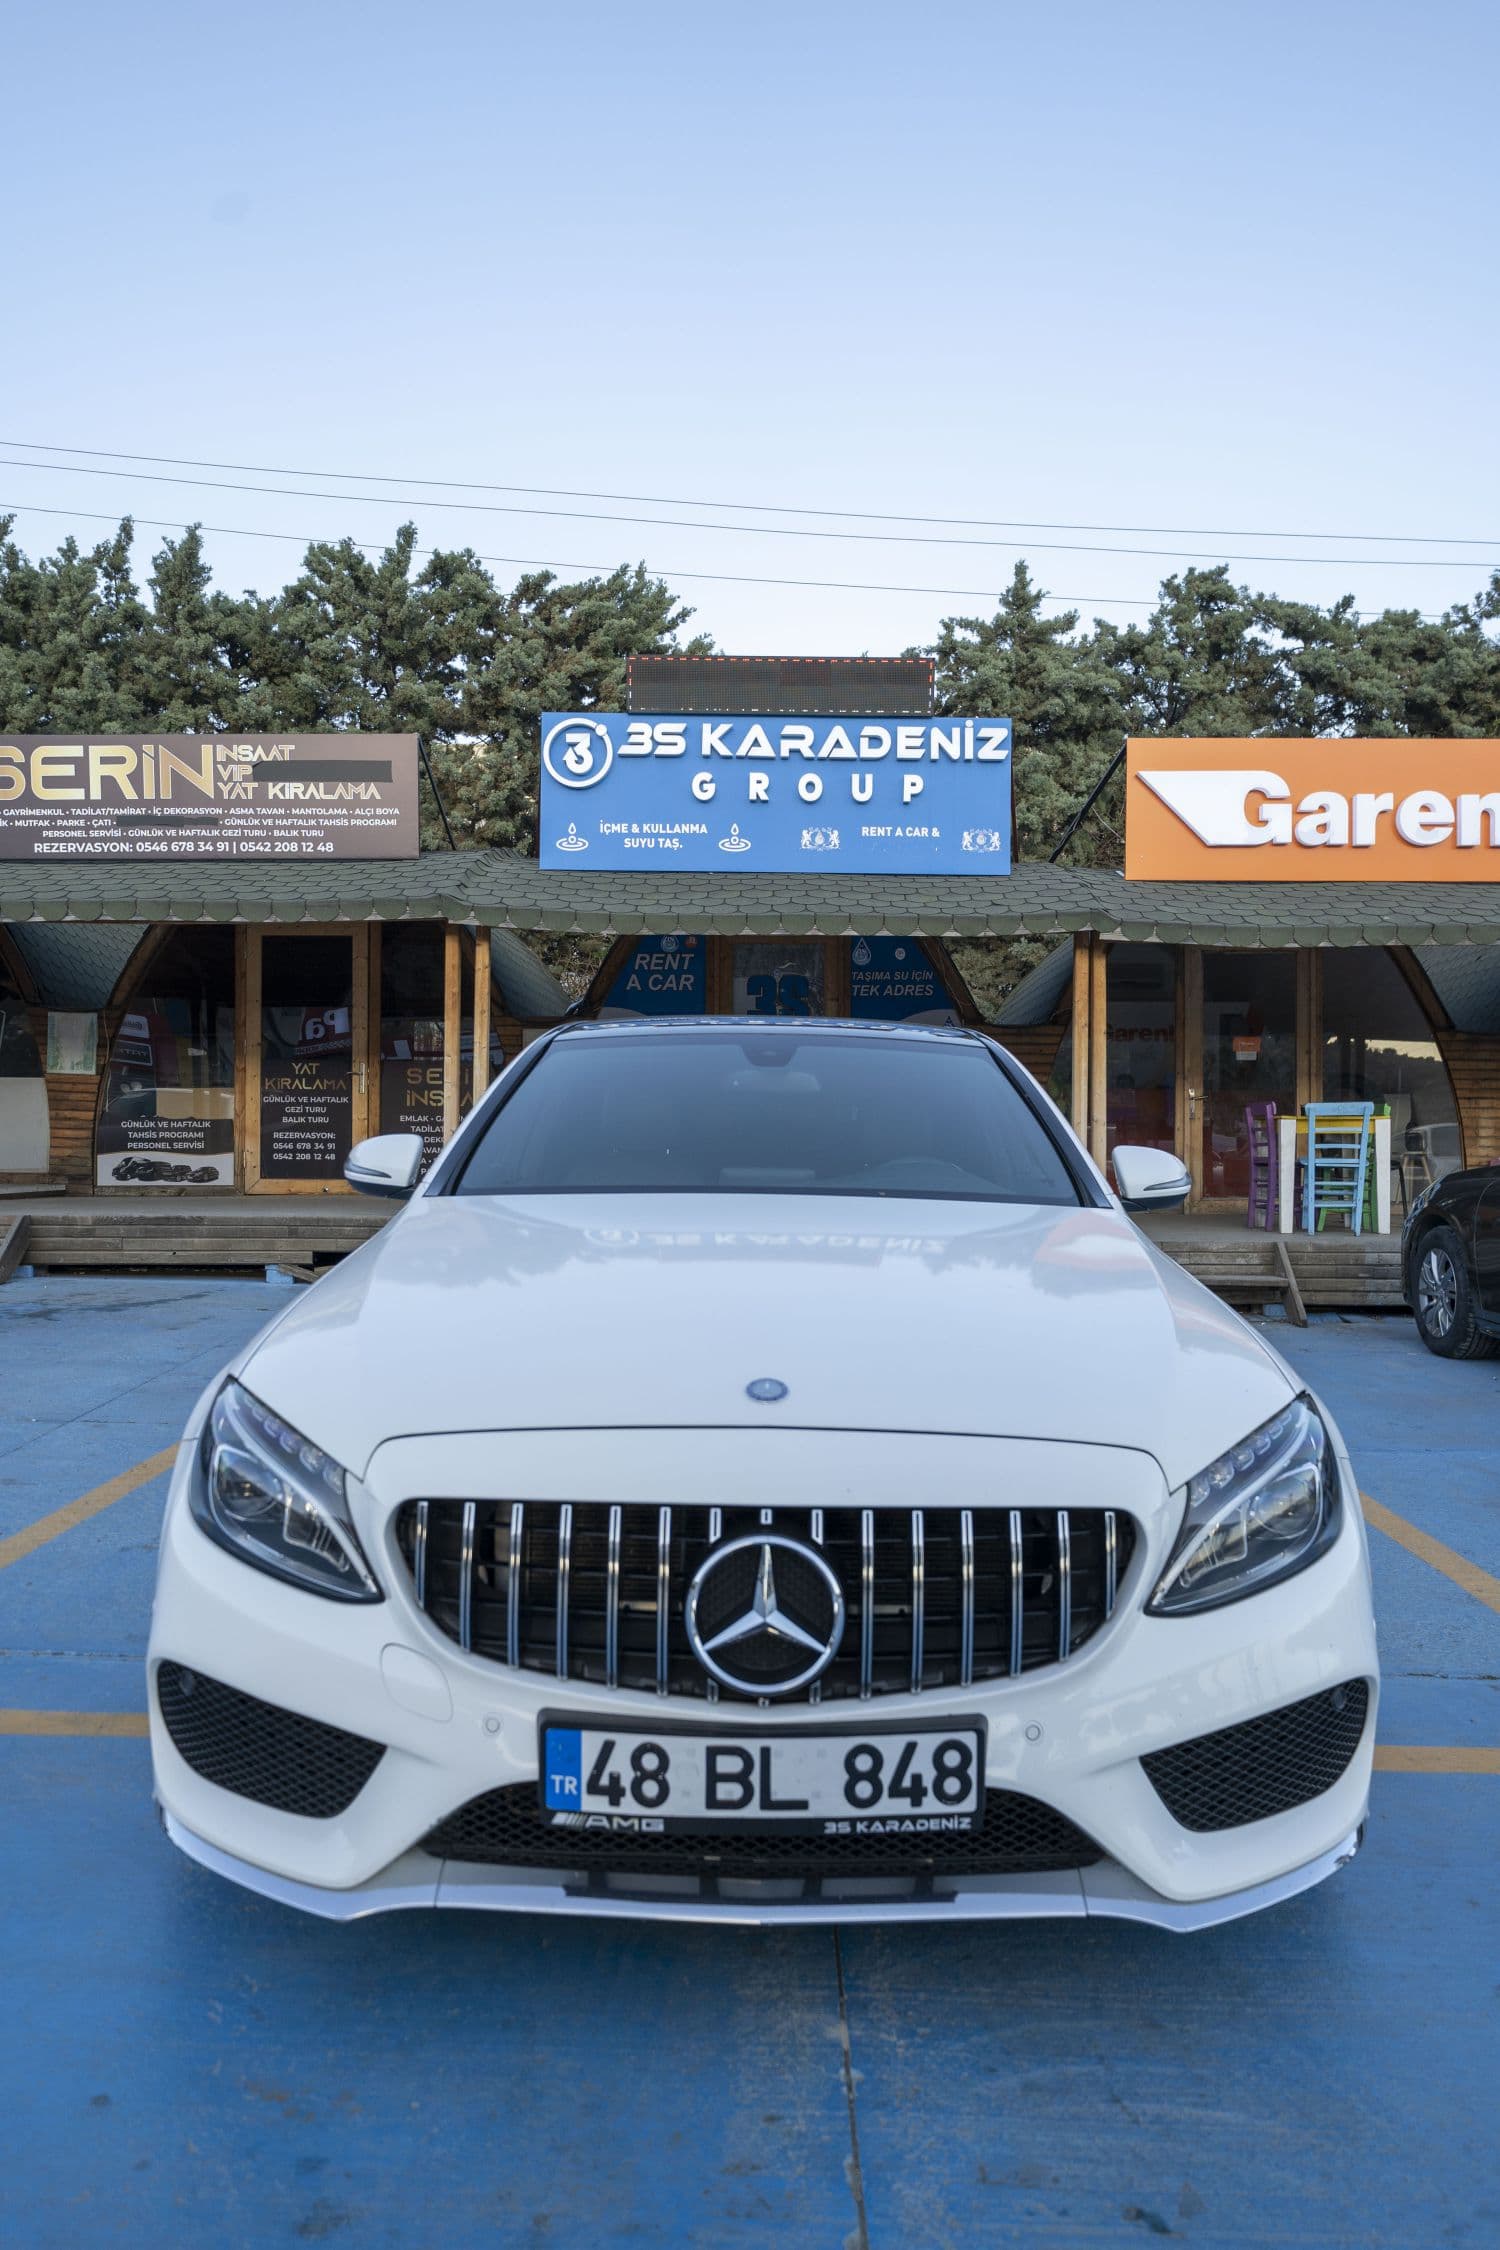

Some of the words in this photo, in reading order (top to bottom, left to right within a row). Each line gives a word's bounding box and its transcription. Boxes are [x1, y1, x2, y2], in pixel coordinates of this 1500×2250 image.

[617, 722, 687, 757] 3S
[701, 720, 1009, 760] KARADENİZ
[216, 764, 253, 782] VIP
[217, 782, 259, 800] YAT
[163, 807, 223, 815] DEKORASYON
[229, 807, 255, 815] ASMA
[256, 807, 285, 815] TAVAN
[291, 807, 348, 815] MANTOLAMA
[355, 807, 374, 816] ALÇI
[375, 807, 400, 815] BOYA
[15, 819, 50, 827] MUTFAK
[57, 819, 86, 827] PARKE
[92, 819, 112, 828] ÇATI
[225, 818, 260, 826] GÜNLÜK
[262, 818, 274, 826] VE
[275, 818, 317, 826] HAFTALIK
[318, 817, 349, 826] TAHSİS
[351, 818, 397, 826] PROGRAMI
[599, 820, 628, 834] İÇME
[643, 823, 708, 834] KULLANMA
[42, 830, 88, 838] PERSONEL
[89, 828, 122, 838] SERVİSİ
[128, 828, 164, 837] GÜNLÜK
[165, 829, 177, 837] VE
[179, 829, 220, 837] HAFTALIK
[222, 828, 242, 837] GEZİ
[244, 829, 267, 837] TURU
[273, 829, 300, 837] BALIK
[301, 829, 324, 837] TURU
[861, 826, 892, 837] RENT
[894, 826, 904, 837] A
[905, 826, 929, 837] CAR
[34, 843, 134, 853] REZERVASYON:
[136, 842, 167, 852] 0546
[171, 842, 194, 852] 678
[197, 841, 213, 852] 34
[217, 842, 229, 852] 91
[240, 842, 271, 852] 0542
[274, 842, 298, 852] 208
[301, 842, 314, 852] 12
[317, 842, 334, 852] 48
[624, 838, 655, 848] SUYU
[634, 953, 695, 970] RENT
[893, 971, 909, 980] SU
[626, 974, 642, 990] A
[648, 974, 695, 991] CAR
[851, 984, 880, 996] TEK
[883, 984, 934, 996] ADRES
[291, 1062, 321, 1075] YAT
[263, 1094, 297, 1103] GÜNLÜK
[285, 1104, 303, 1113] GEZİ
[121, 1120, 156, 1128] GÜNLÜK
[128, 1130, 157, 1138] TAHSİS
[173, 1141, 205, 1149] SERVİSİ
[273, 1142, 294, 1150] 0546
[296, 1142, 312, 1150] 678
[314, 1142, 325, 1150] 34
[327, 1142, 336, 1150] 91
[586, 1739, 671, 1809] 48
[705, 1745, 809, 1811] BL
[843, 1738, 973, 1809] 848
[551, 1774, 578, 1795] TR
[824, 1821, 851, 1835] 3S
[856, 1814, 972, 1834] KARADENİZ
